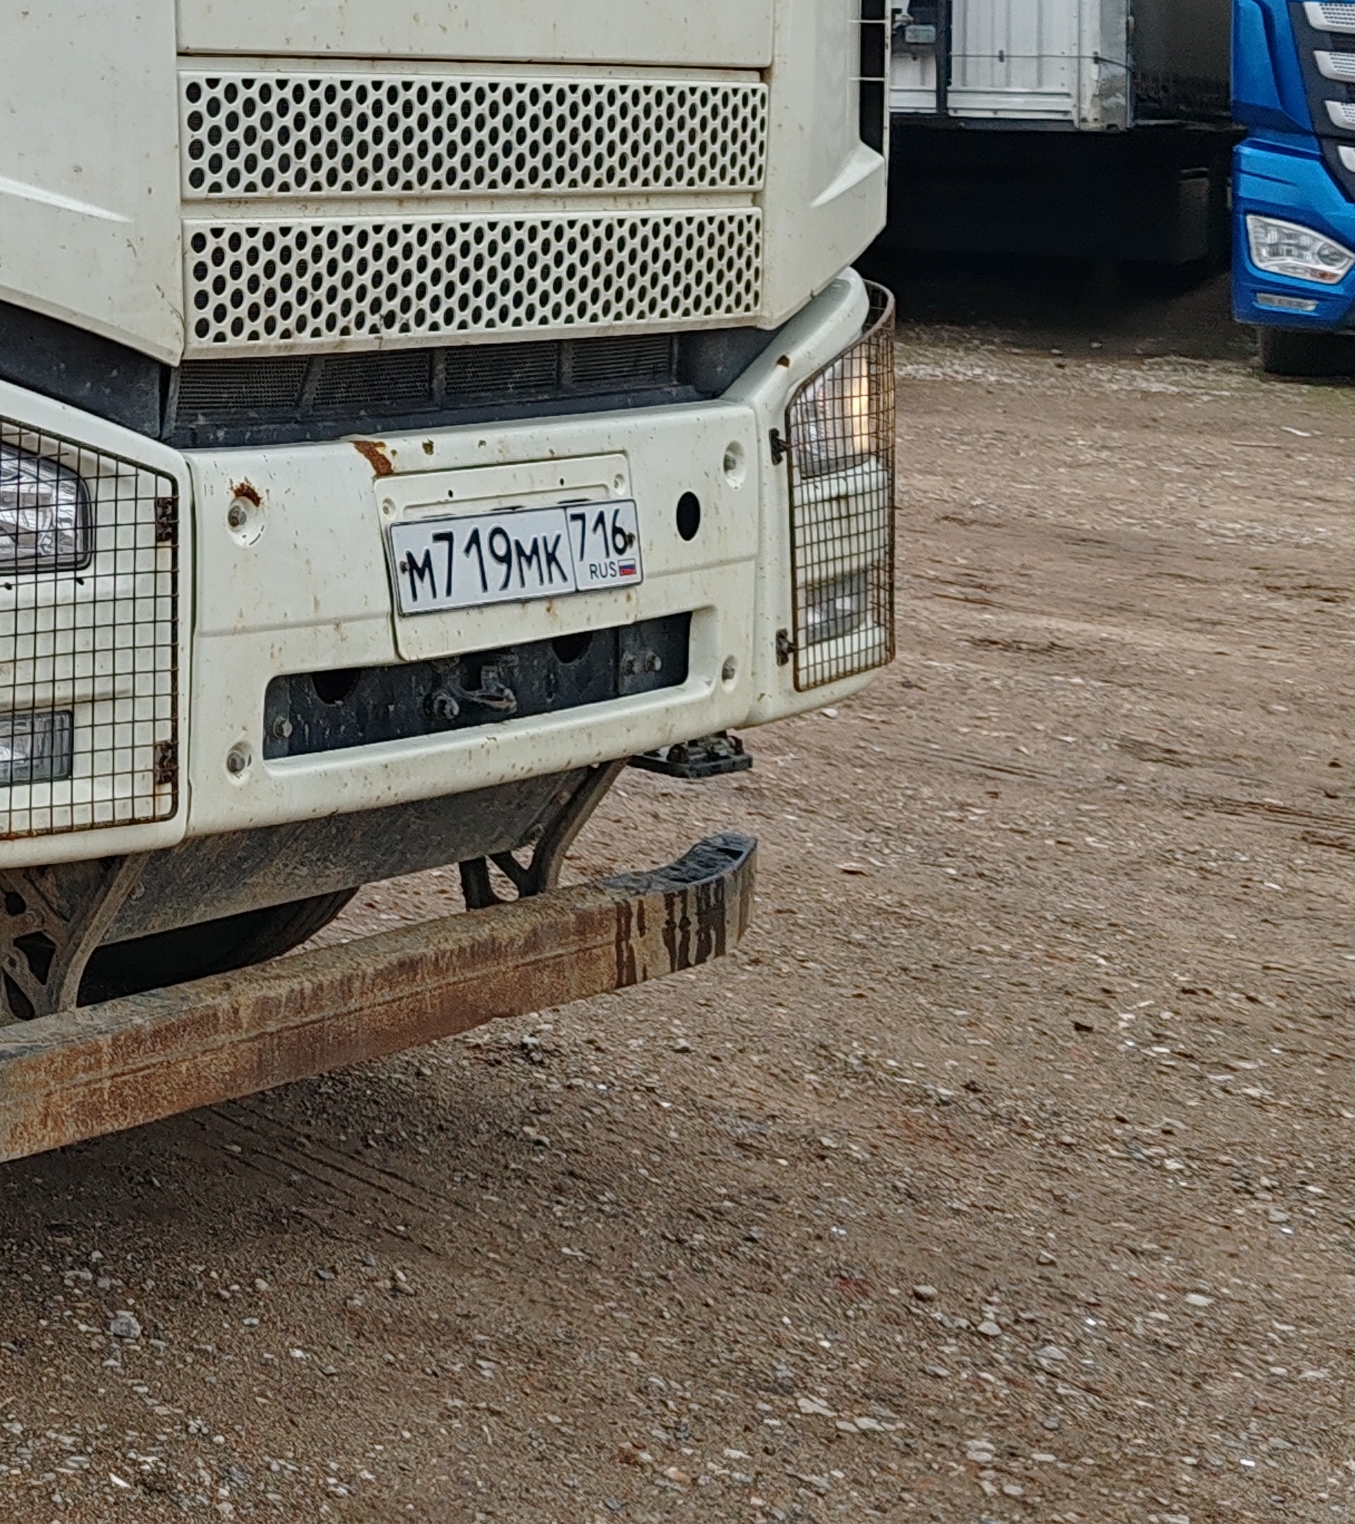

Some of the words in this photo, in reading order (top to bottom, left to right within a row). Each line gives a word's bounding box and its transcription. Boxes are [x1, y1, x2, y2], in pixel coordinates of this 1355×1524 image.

[405, 526, 569, 602] М719МК
[569, 508, 629, 562] 716
[589, 560, 618, 580] RUS
